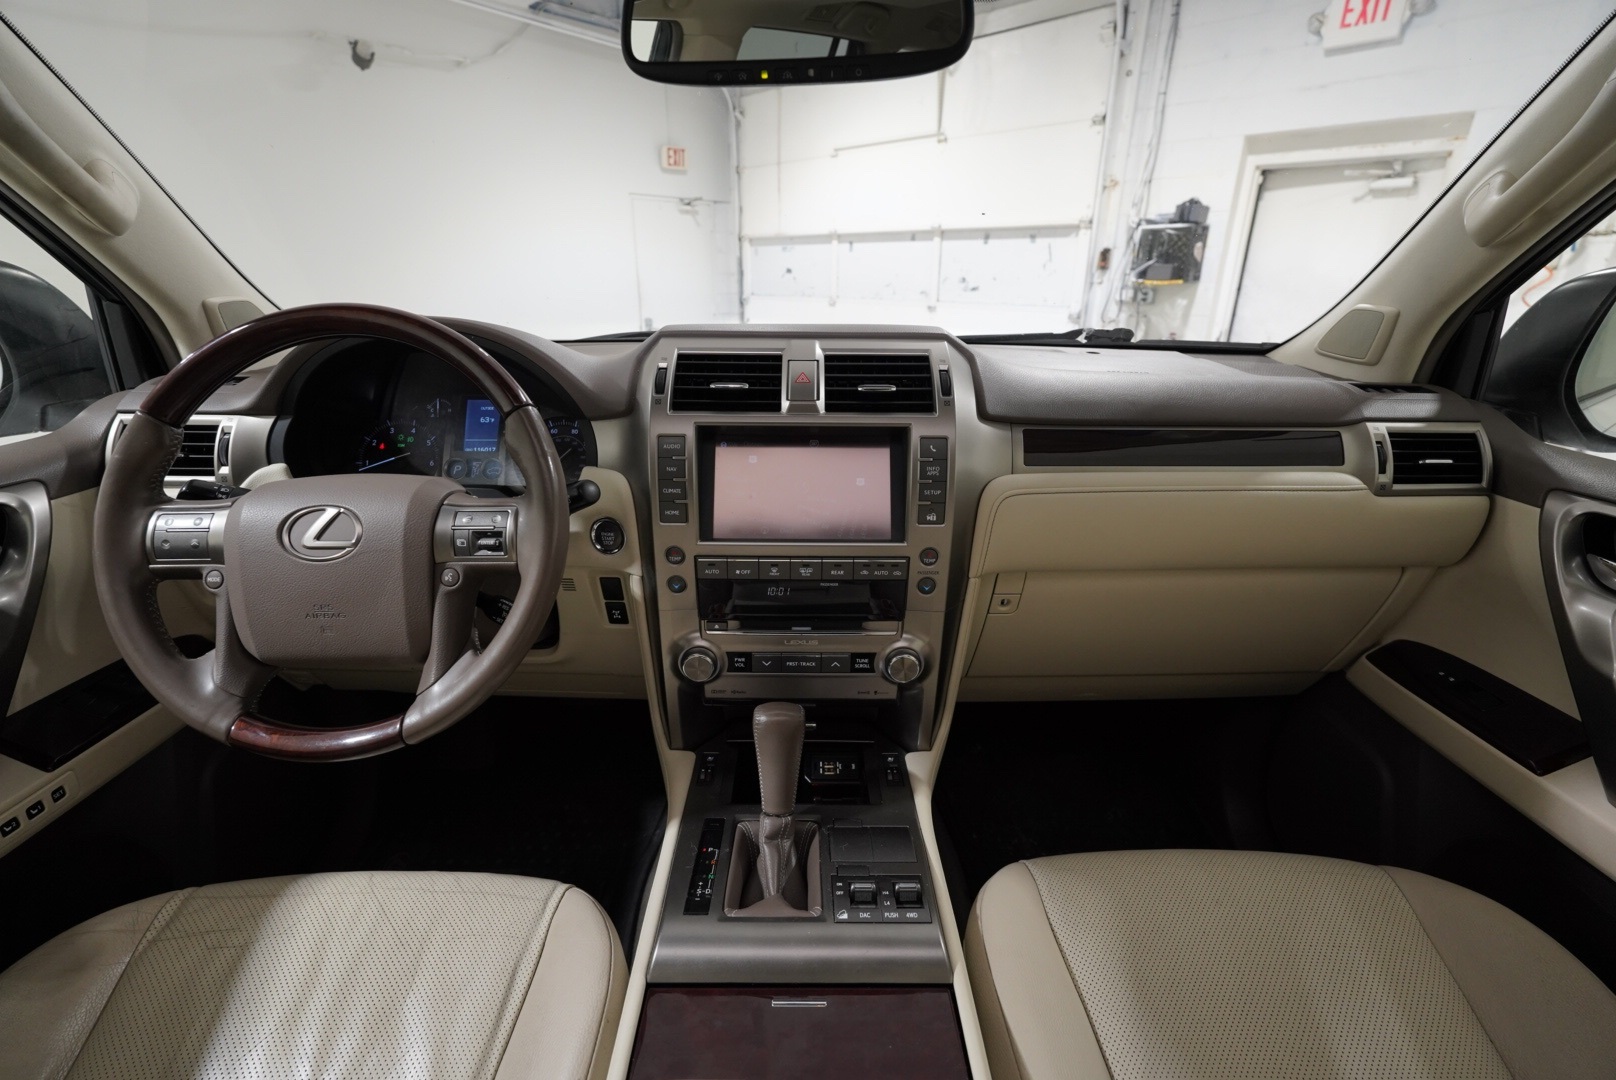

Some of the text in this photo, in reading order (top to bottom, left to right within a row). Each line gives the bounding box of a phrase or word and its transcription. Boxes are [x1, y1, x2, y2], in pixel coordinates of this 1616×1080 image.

[667, 146, 686, 167] EXIT
[371, 439, 377, 447] 2
[767, 586, 791, 596] 10:01
[52, 789, 64, 800] SET
